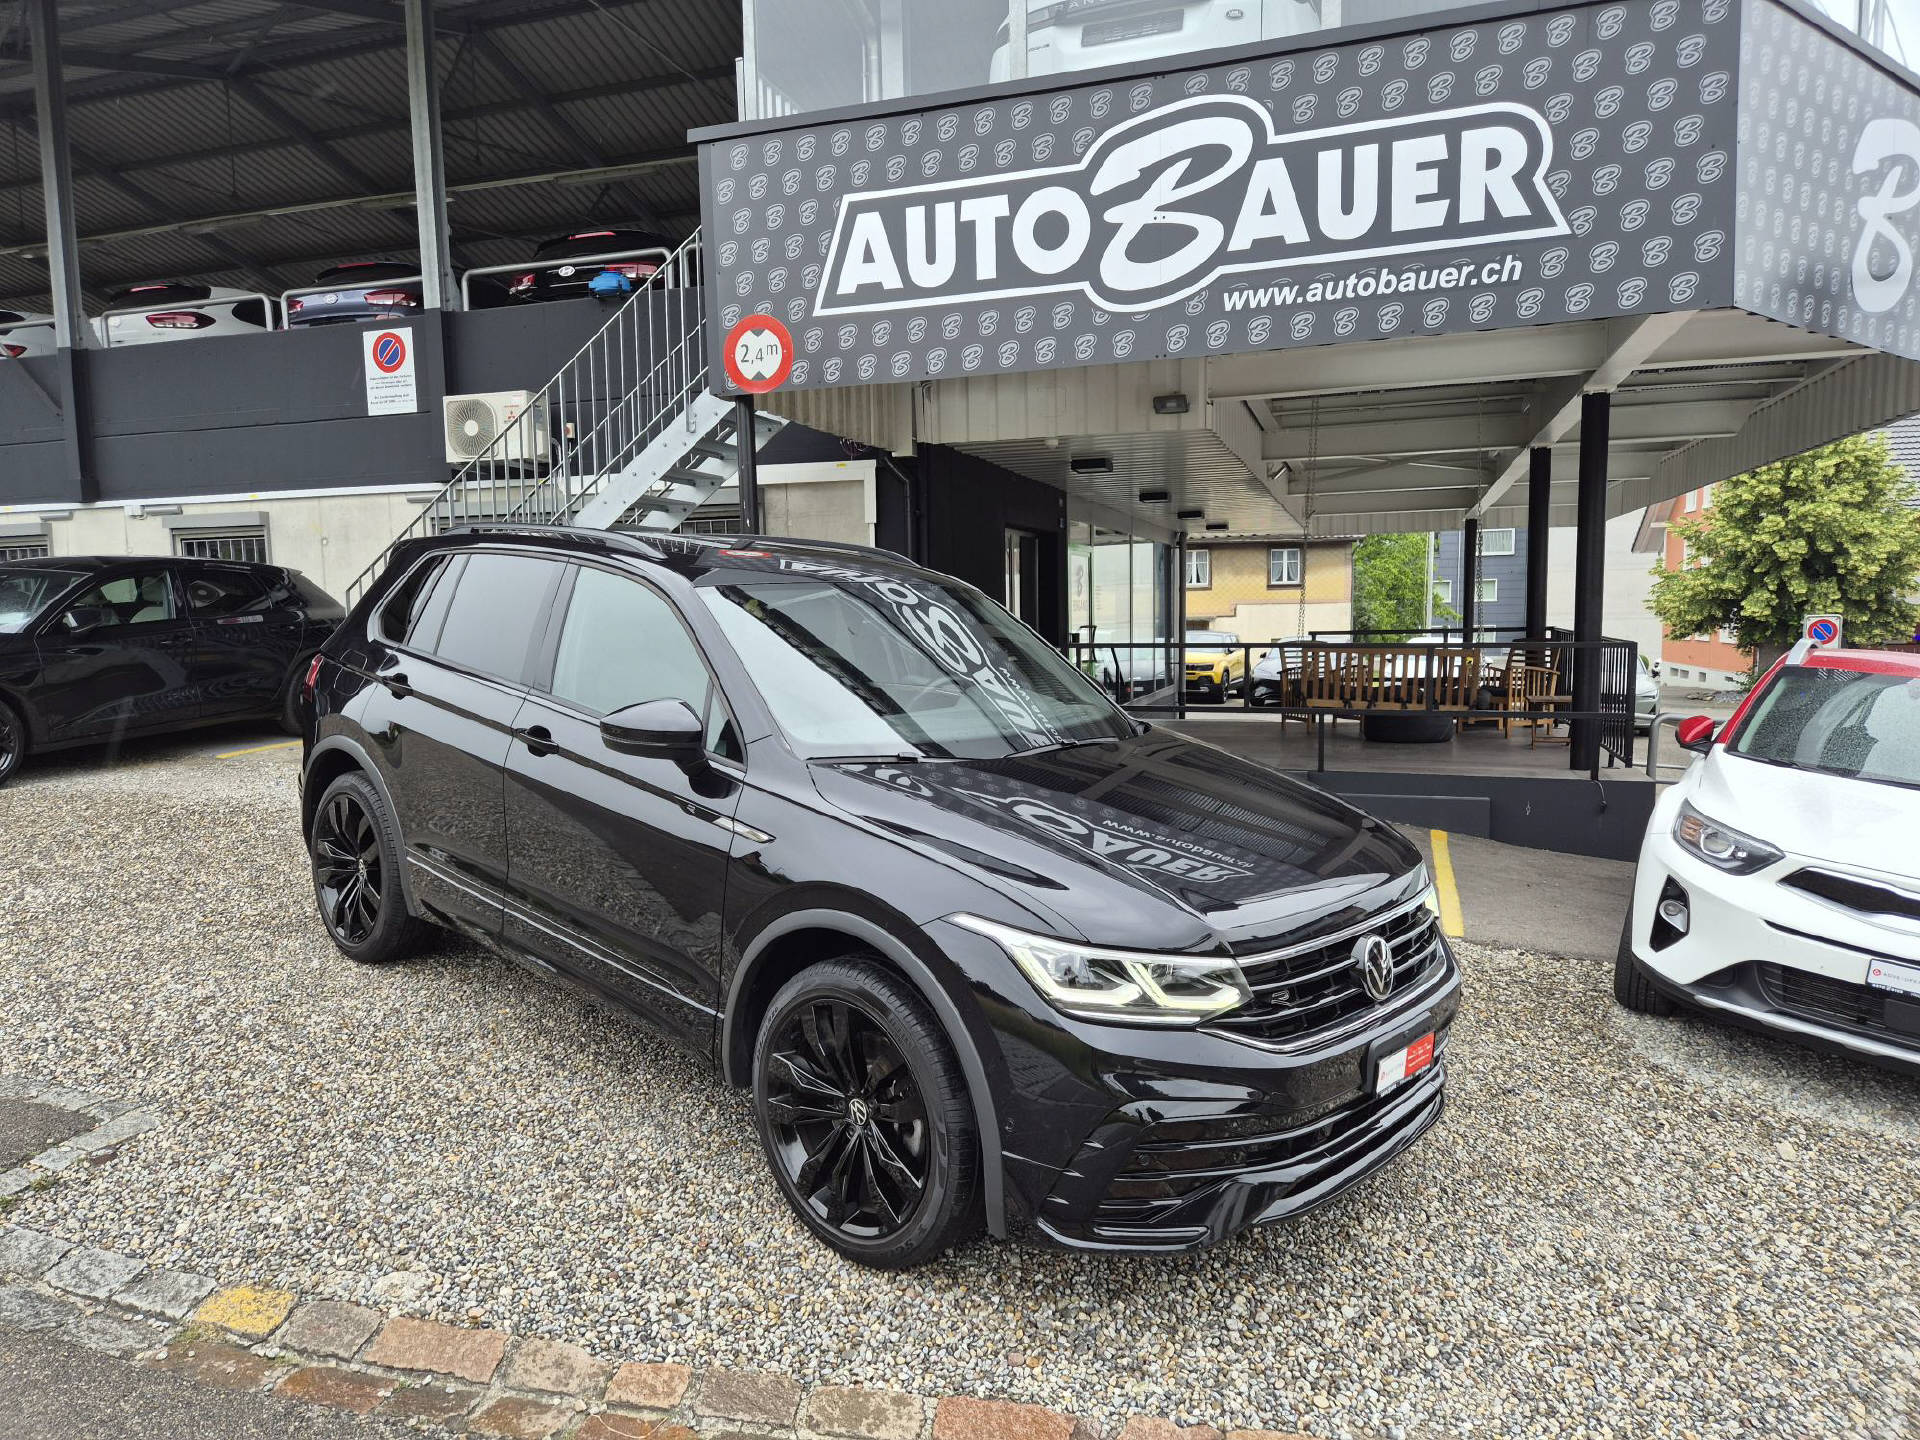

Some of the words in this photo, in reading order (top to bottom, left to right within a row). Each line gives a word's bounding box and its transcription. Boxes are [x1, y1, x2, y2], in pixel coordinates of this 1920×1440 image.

[836, 186, 1091, 295] AUTO
[1090, 117, 1532, 291] BAUER
[1222, 255, 1523, 312] www.autobauer.ch
